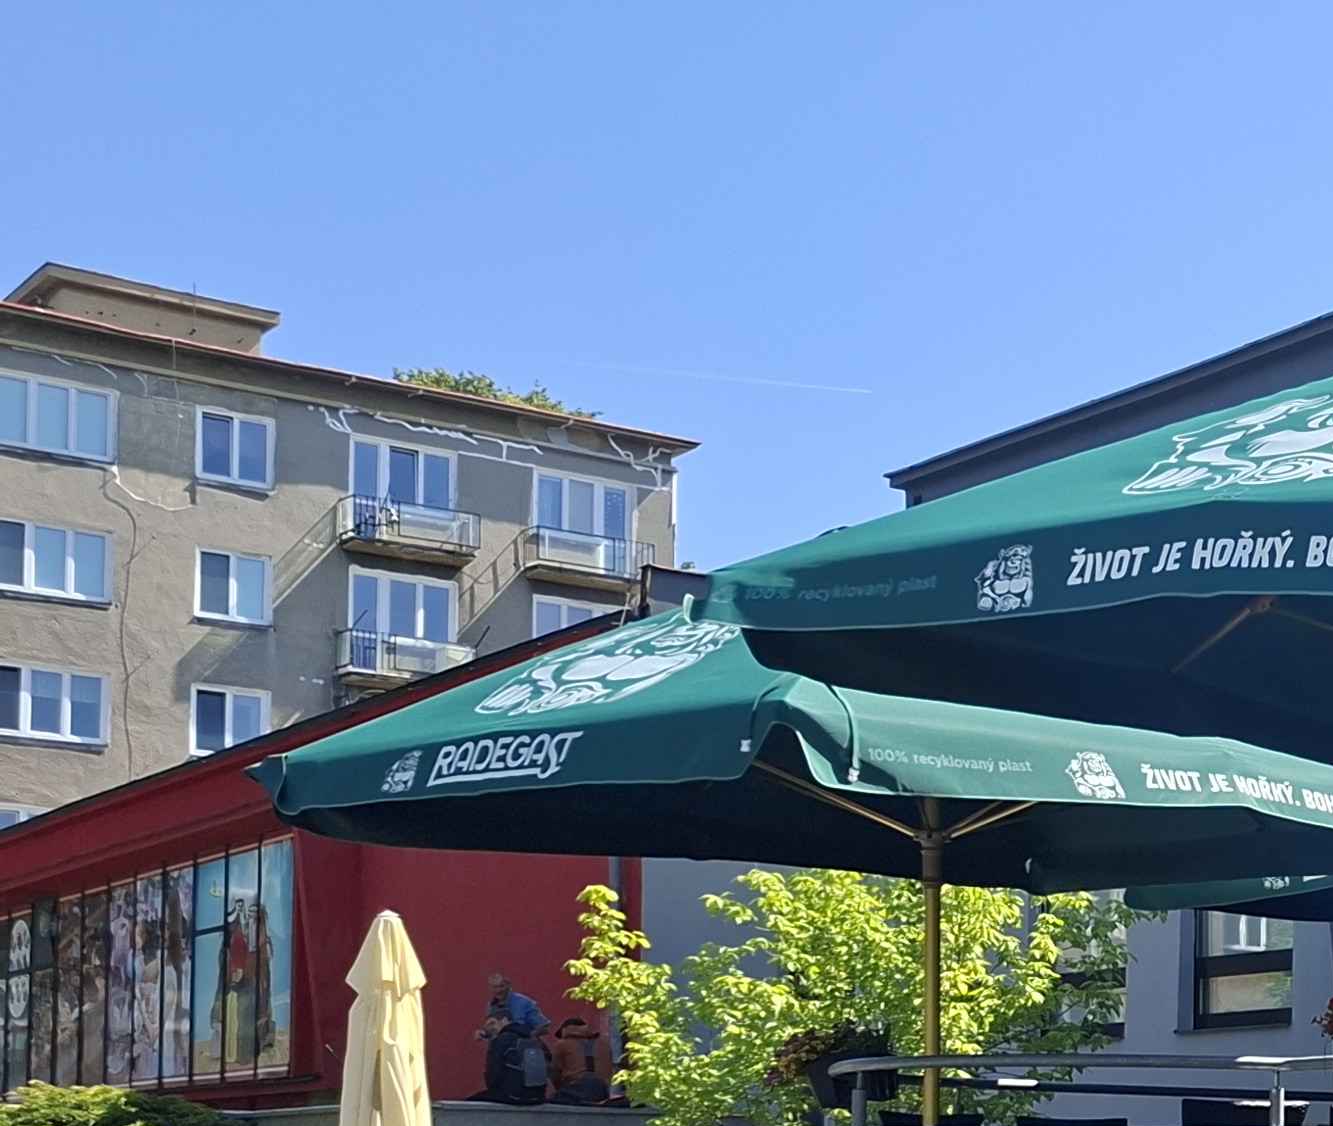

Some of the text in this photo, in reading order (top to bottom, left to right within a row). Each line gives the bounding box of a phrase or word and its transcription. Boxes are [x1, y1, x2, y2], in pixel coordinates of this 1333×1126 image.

[1066, 547, 1149, 586] ŽIVOT
[1151, 541, 1186, 574] JE
[1191, 530, 1295, 570] HOŘKÝ.
[426, 730, 584, 787] RADEGAST
[868, 748, 1033, 773] 100% recyklovaný plast
[1140, 763, 1202, 792] ŽIVOT
[1208, 773, 1234, 793] JE
[1233, 774, 1301, 807] HOŘKÝ.
